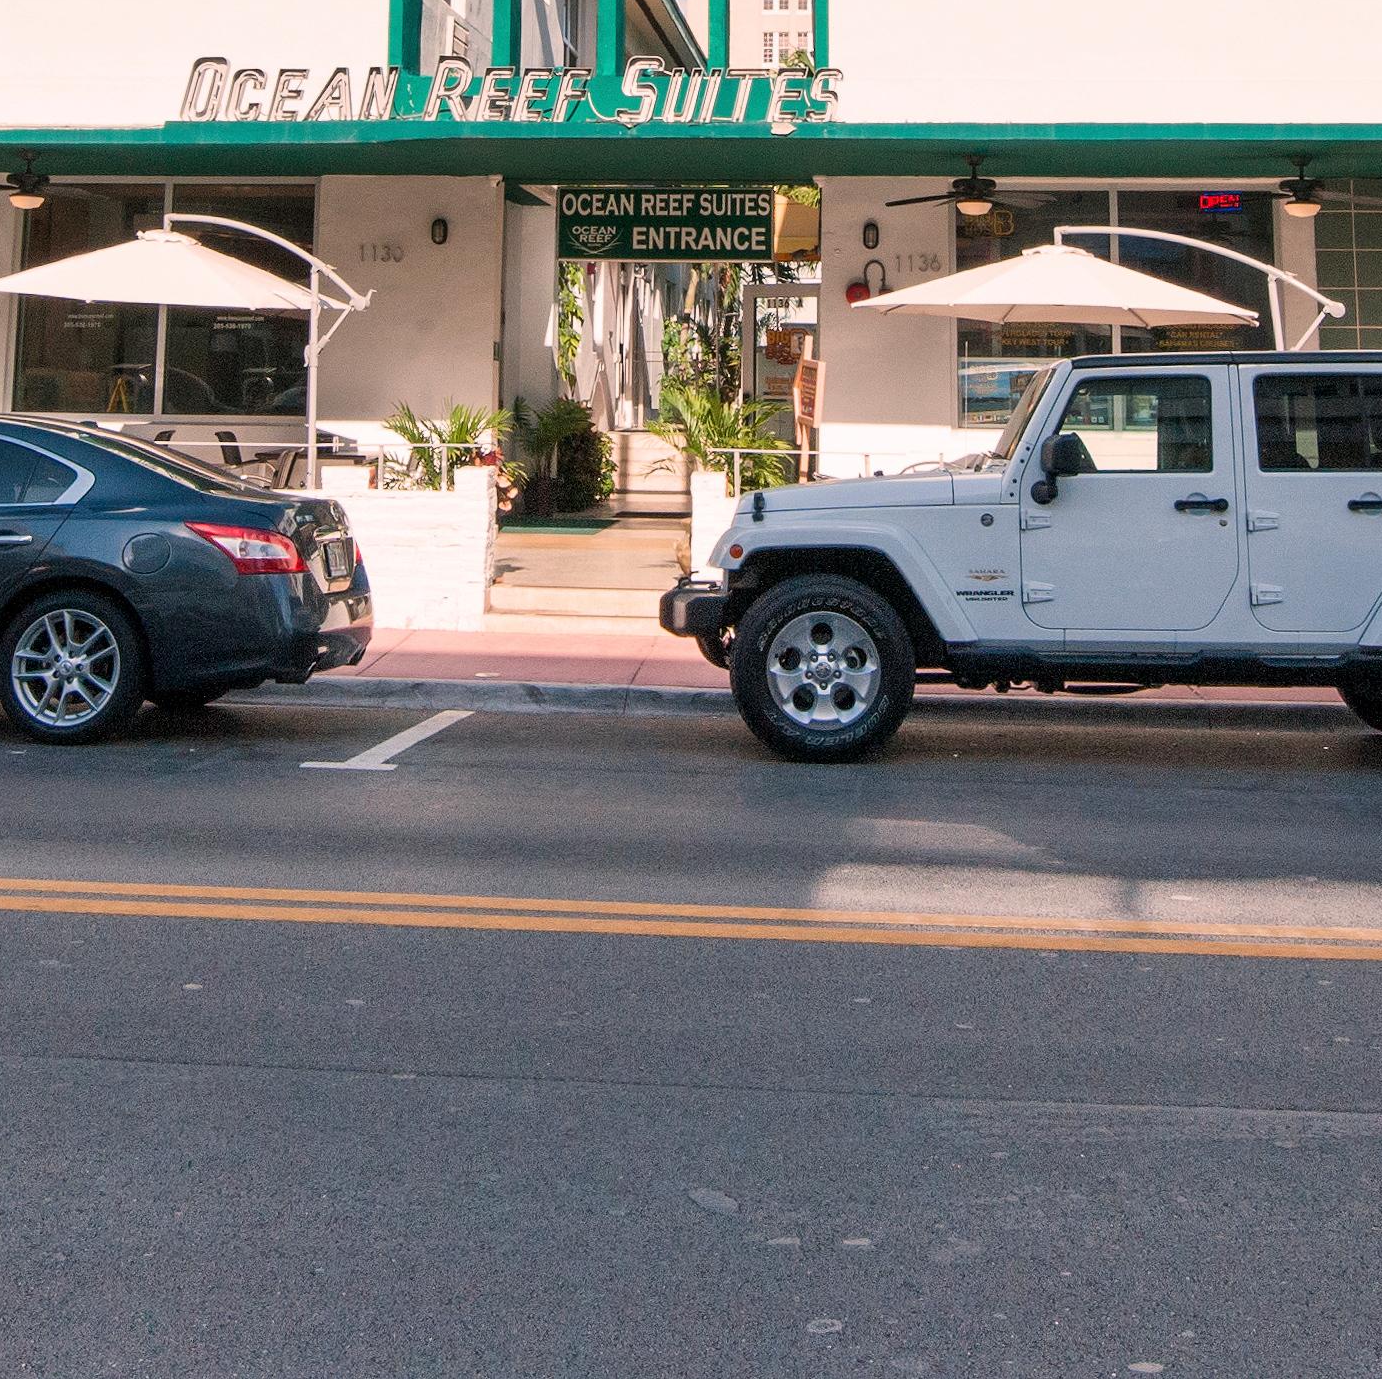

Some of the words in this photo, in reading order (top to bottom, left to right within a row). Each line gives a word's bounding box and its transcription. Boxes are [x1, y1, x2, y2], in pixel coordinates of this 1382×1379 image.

[180, 56, 399, 121] OCEAN
[423, 55, 593, 121] REEF
[616, 56, 844, 123] SUITES
[562, 193, 635, 217] OCEAN
[640, 193, 695, 217] REEF
[699, 193, 771, 217] SUITES
[572, 225, 617, 236] OCEAN
[632, 226, 767, 251] ENTRANCE
[579, 234, 613, 243] REEF
[359, 244, 405, 263] 1130
